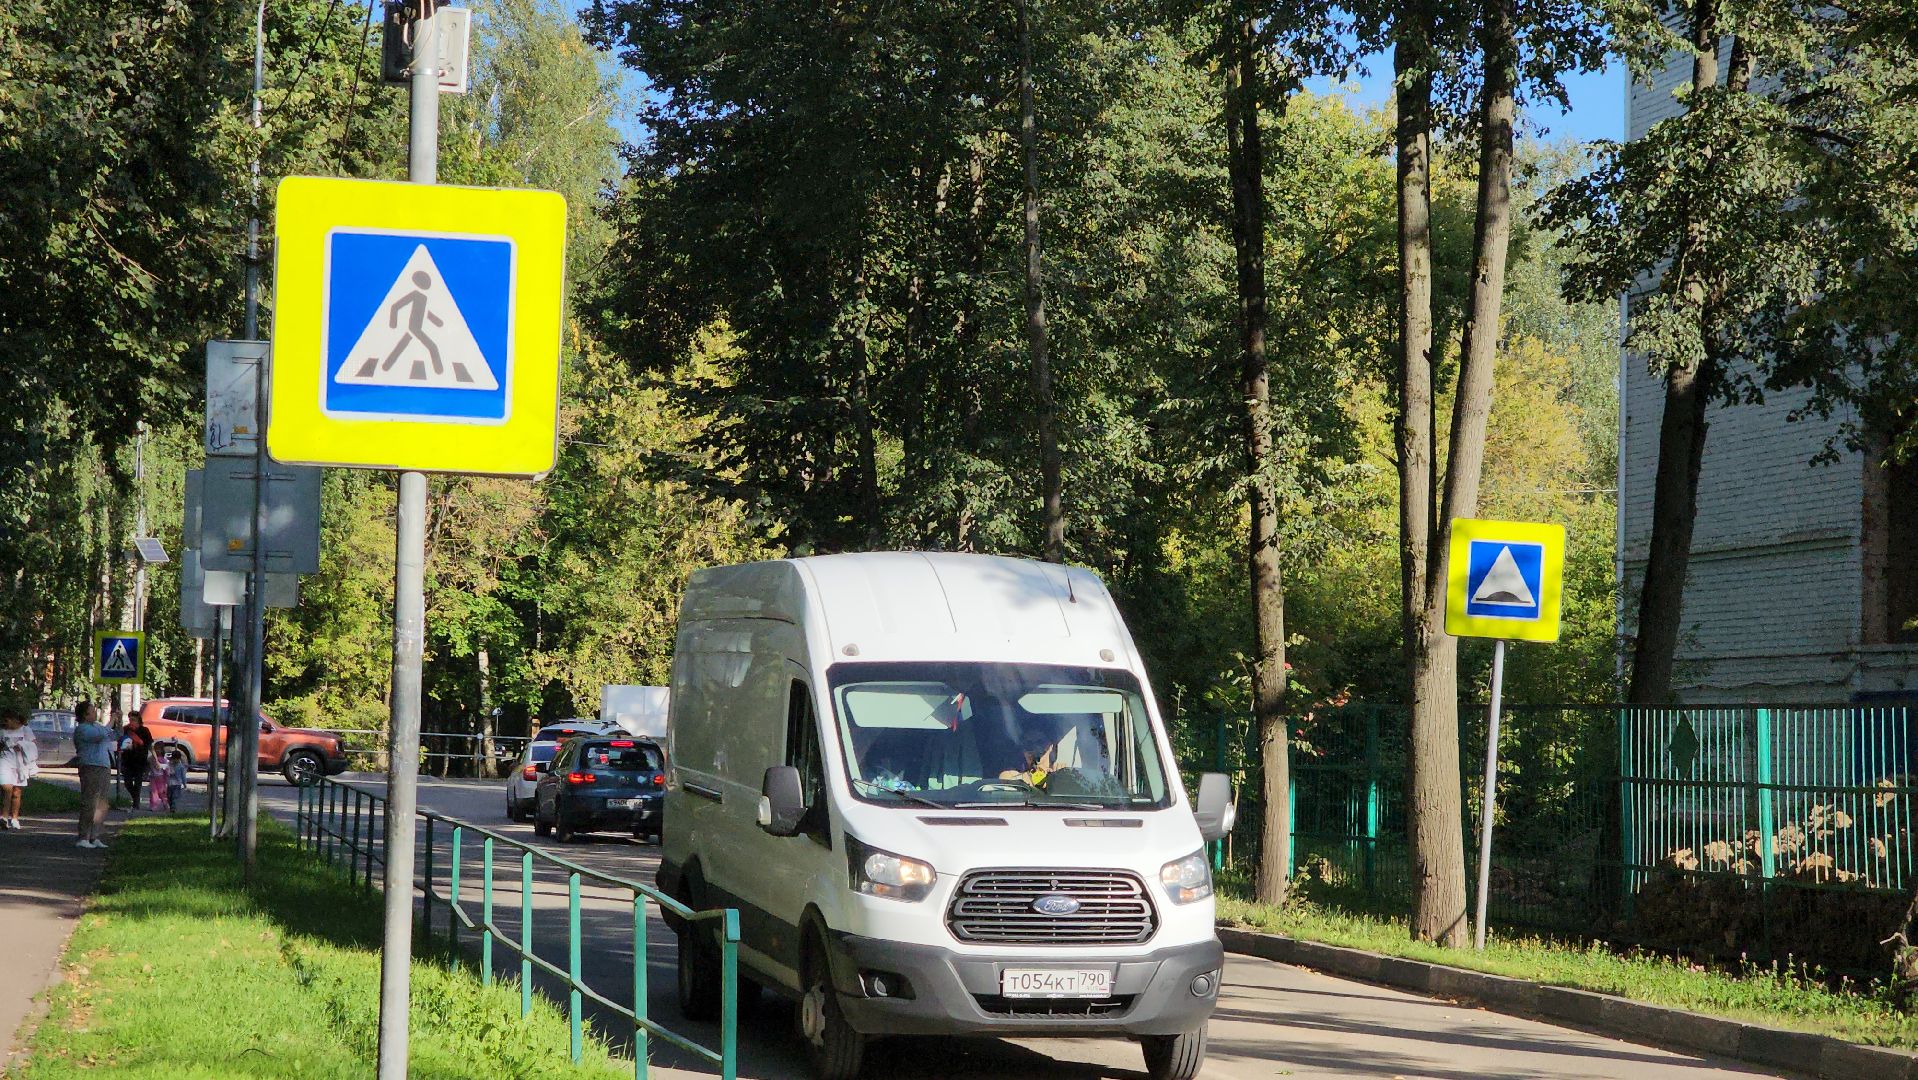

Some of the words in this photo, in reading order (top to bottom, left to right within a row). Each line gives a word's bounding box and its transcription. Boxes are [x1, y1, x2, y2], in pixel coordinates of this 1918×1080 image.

[1043, 899, 1071, 911] Ford
[1010, 973, 1075, 990] Т054КТ
[1080, 972, 1105, 986] 790
